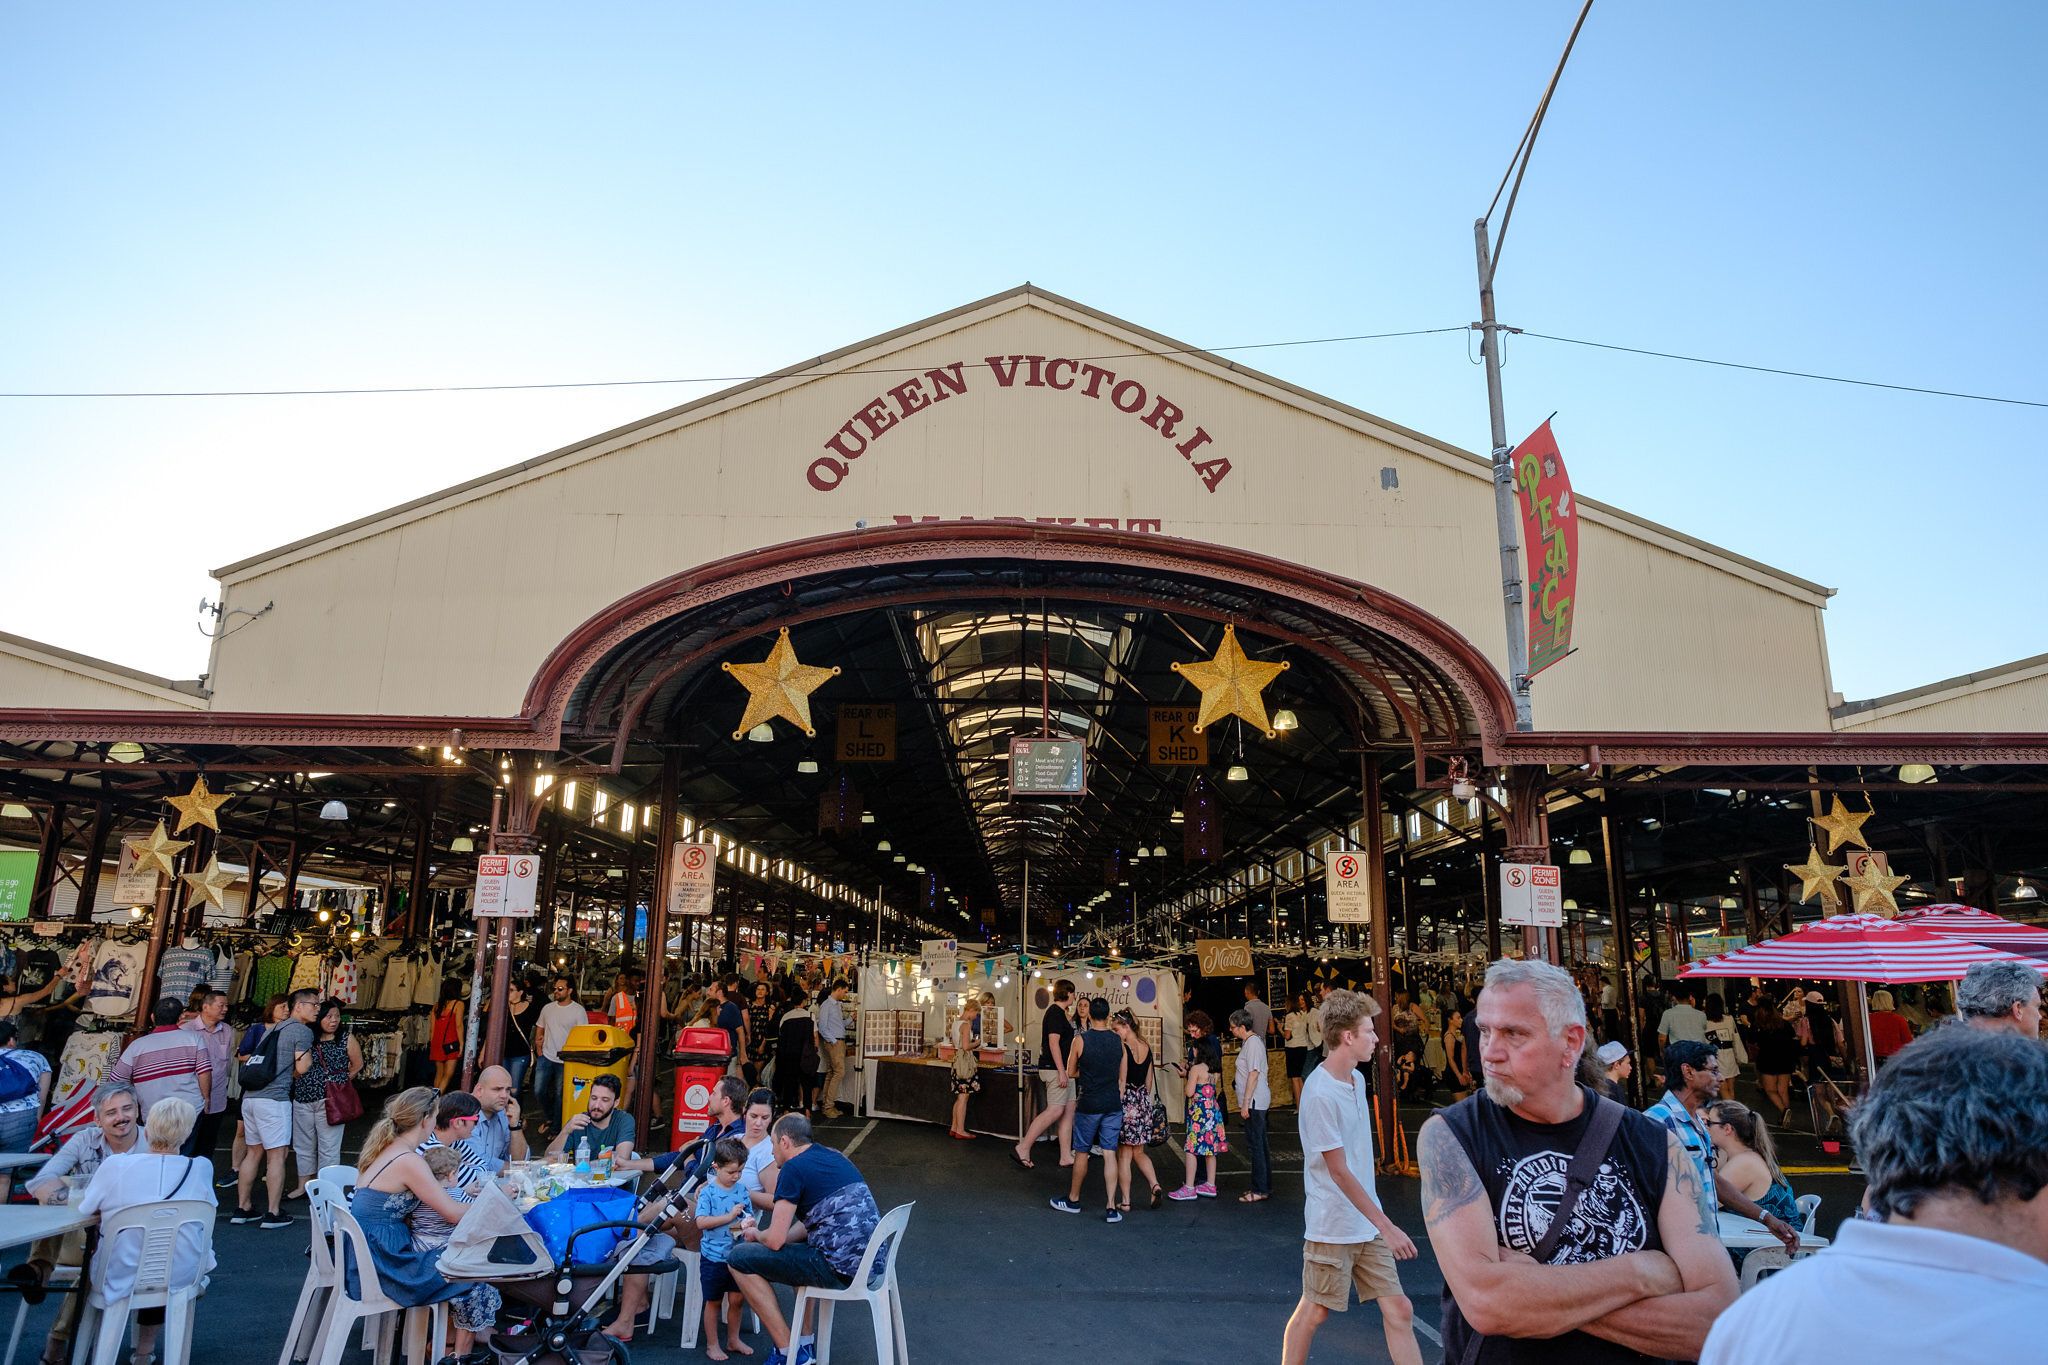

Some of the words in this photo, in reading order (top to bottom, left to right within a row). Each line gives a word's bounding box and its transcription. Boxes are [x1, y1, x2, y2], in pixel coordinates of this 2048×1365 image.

[806, 361, 968, 492] QUEEN
[985, 355, 1233, 493] VICTORIA
[1519, 453, 1571, 654] PEACE
[842, 708, 872, 719] REAR
[877, 708, 891, 719] OF
[1154, 711, 1182, 722] REAR
[859, 720, 874, 738] L
[1169, 725, 1185, 743] K
[846, 743, 886, 757] SHED
[1158, 745, 1199, 761] SHED
[481, 859, 507, 867] PERMIT
[481, 866, 505, 874] ZONE
[681, 871, 705, 880] AREA
[1533, 869, 1557, 877] PERMIT
[1336, 880, 1360, 888] AREA
[1534, 877, 1557, 885] ZONE
[1075, 988, 1131, 1005] veraddict
[1505, 1156, 1568, 1254] ARLEY-DAVIDSO
